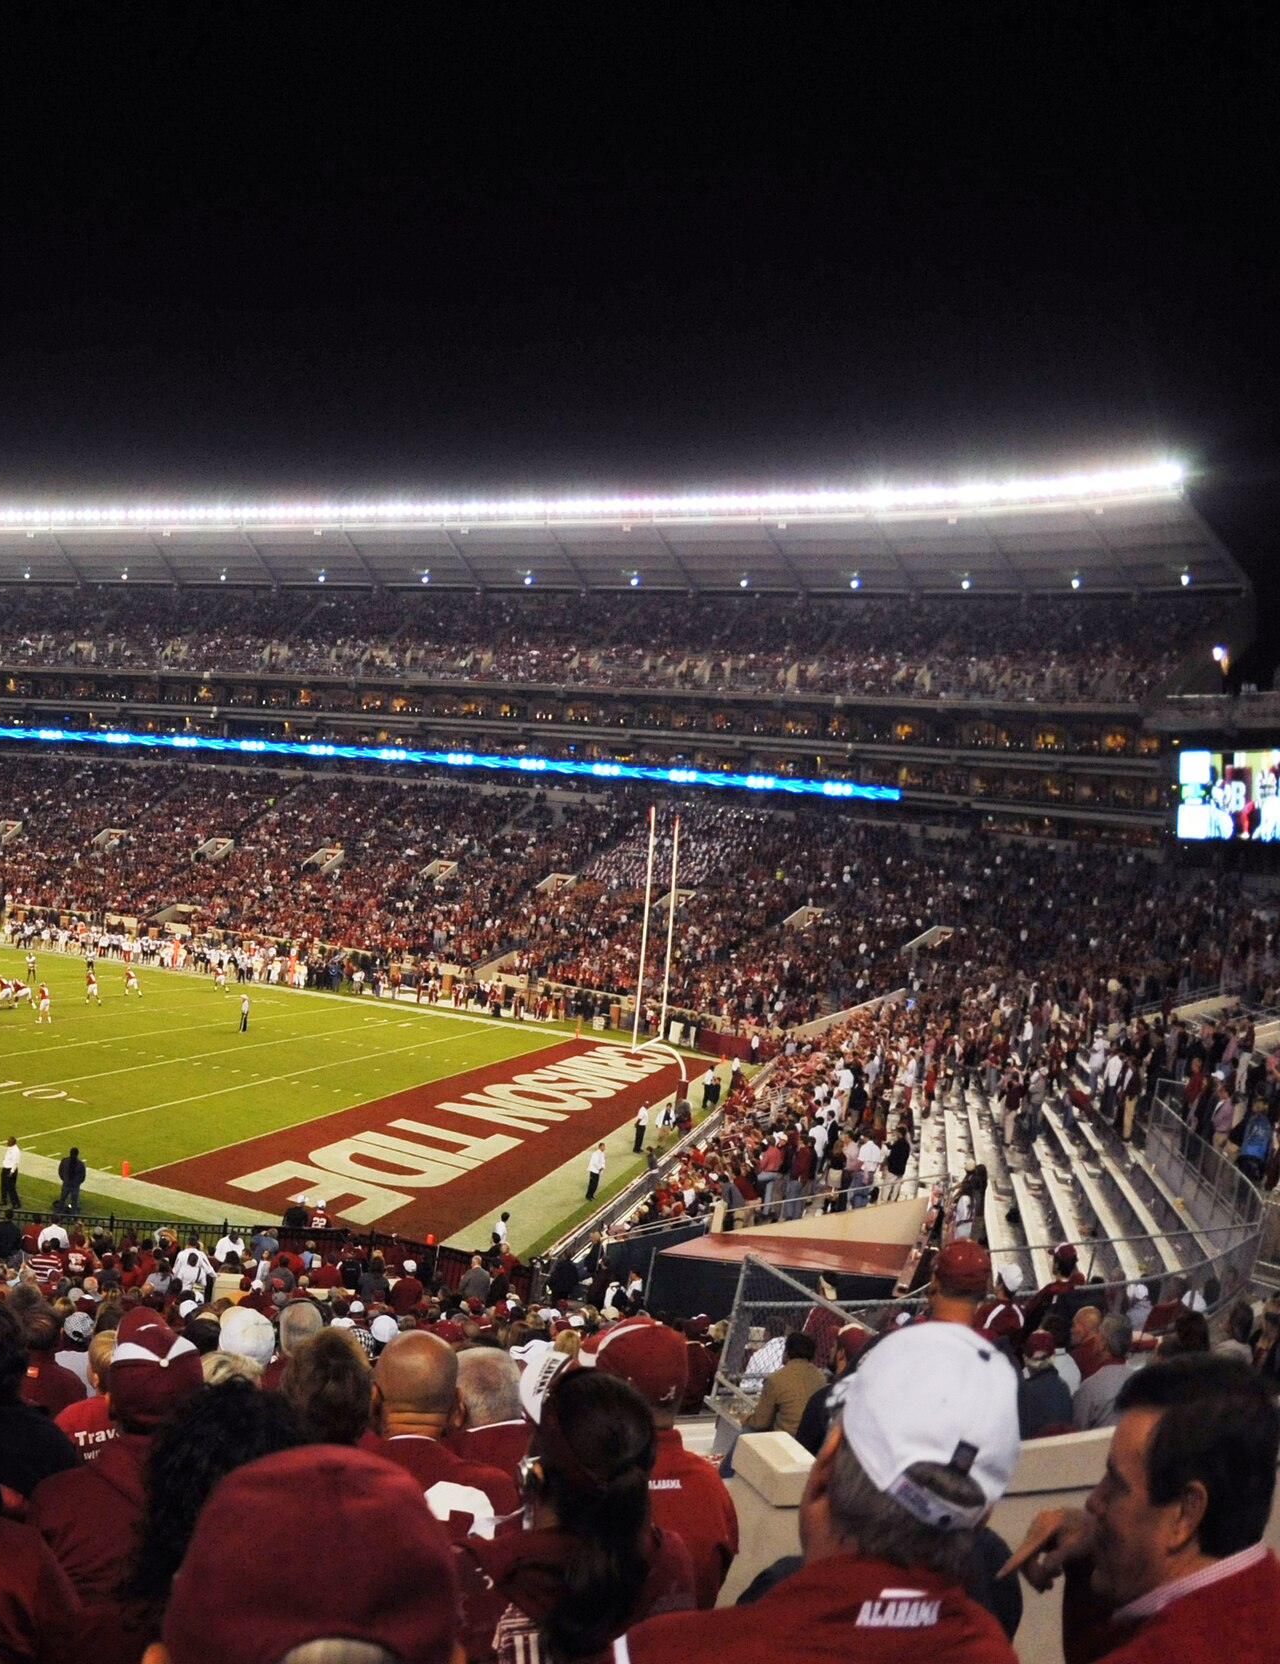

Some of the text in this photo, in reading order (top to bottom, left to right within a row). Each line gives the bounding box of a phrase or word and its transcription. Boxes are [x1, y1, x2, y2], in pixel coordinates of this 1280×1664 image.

[226, 1045, 677, 1225] CRIMSON TIDE
[311, 1216, 327, 1229] 22
[74, 1428, 120, 1447] Trav
